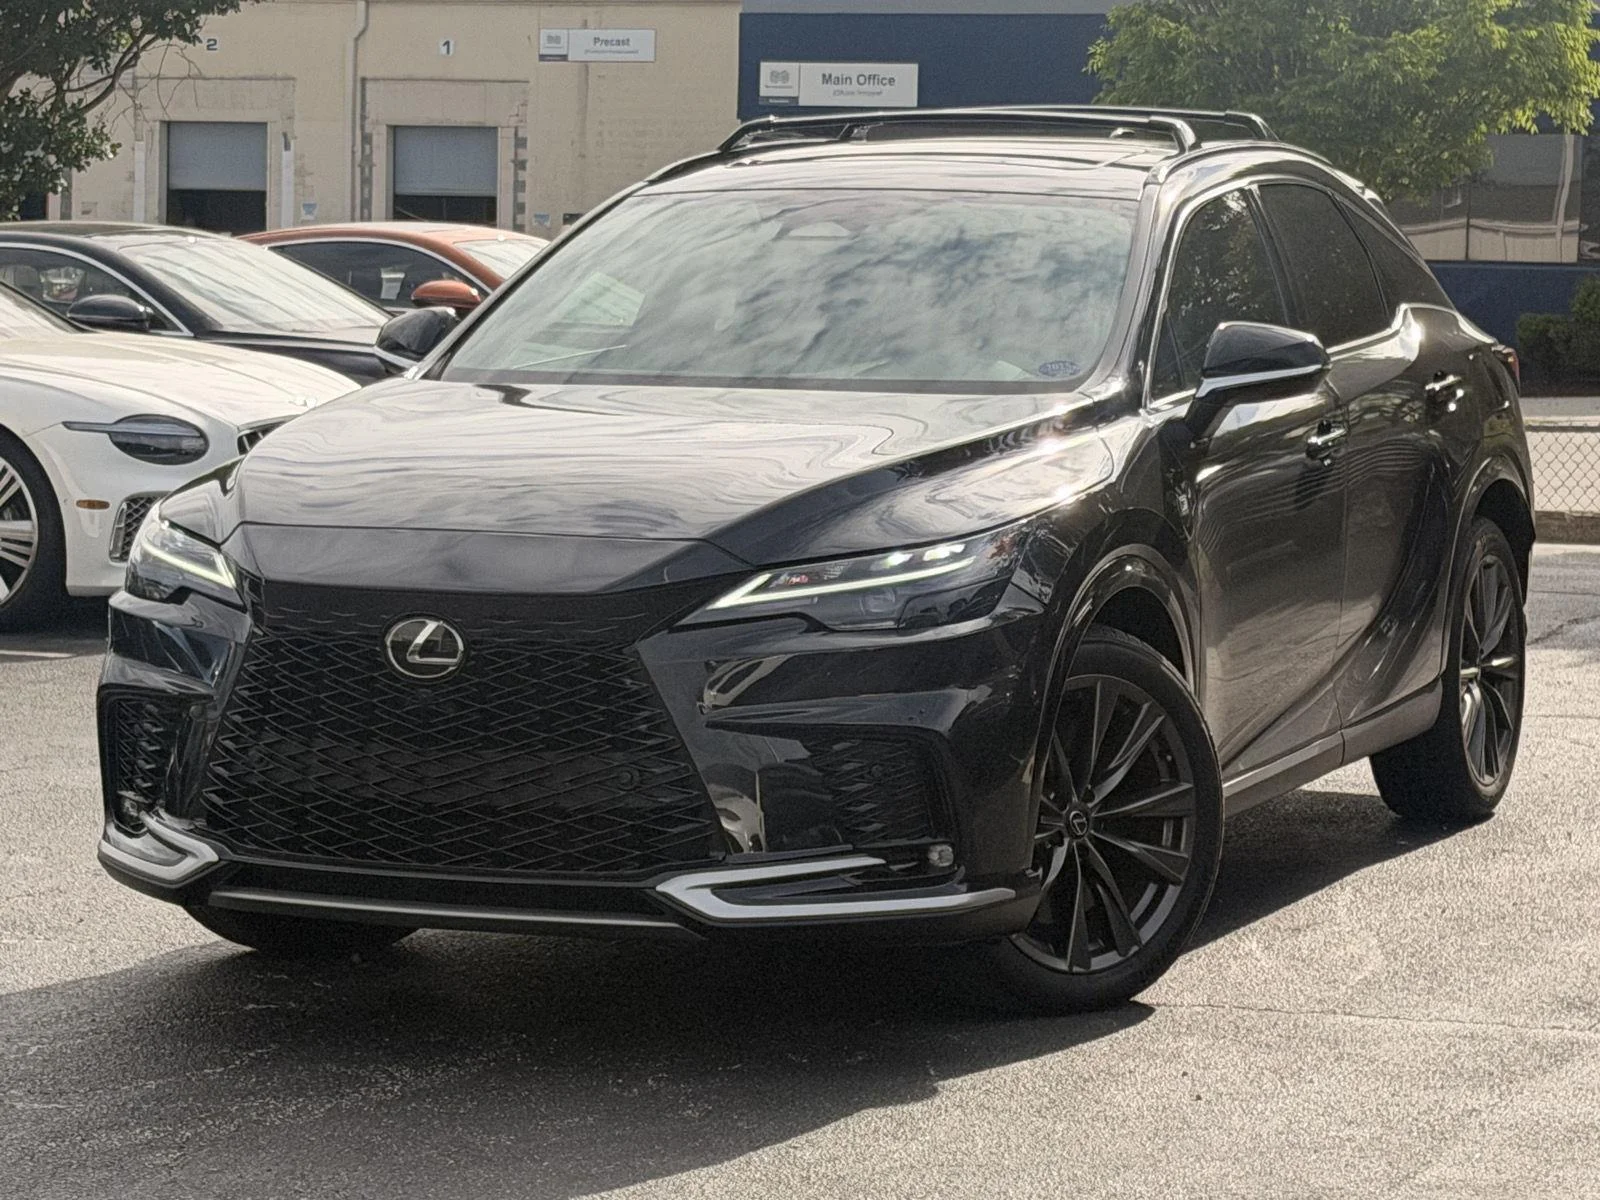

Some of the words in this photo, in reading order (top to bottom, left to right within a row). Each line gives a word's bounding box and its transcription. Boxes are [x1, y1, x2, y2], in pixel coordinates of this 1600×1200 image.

[206, 38, 218, 51] 2
[442, 39, 450, 56] 1
[593, 36, 631, 47] Precast
[821, 73, 853, 86] Main
[856, 73, 896, 87] Office
